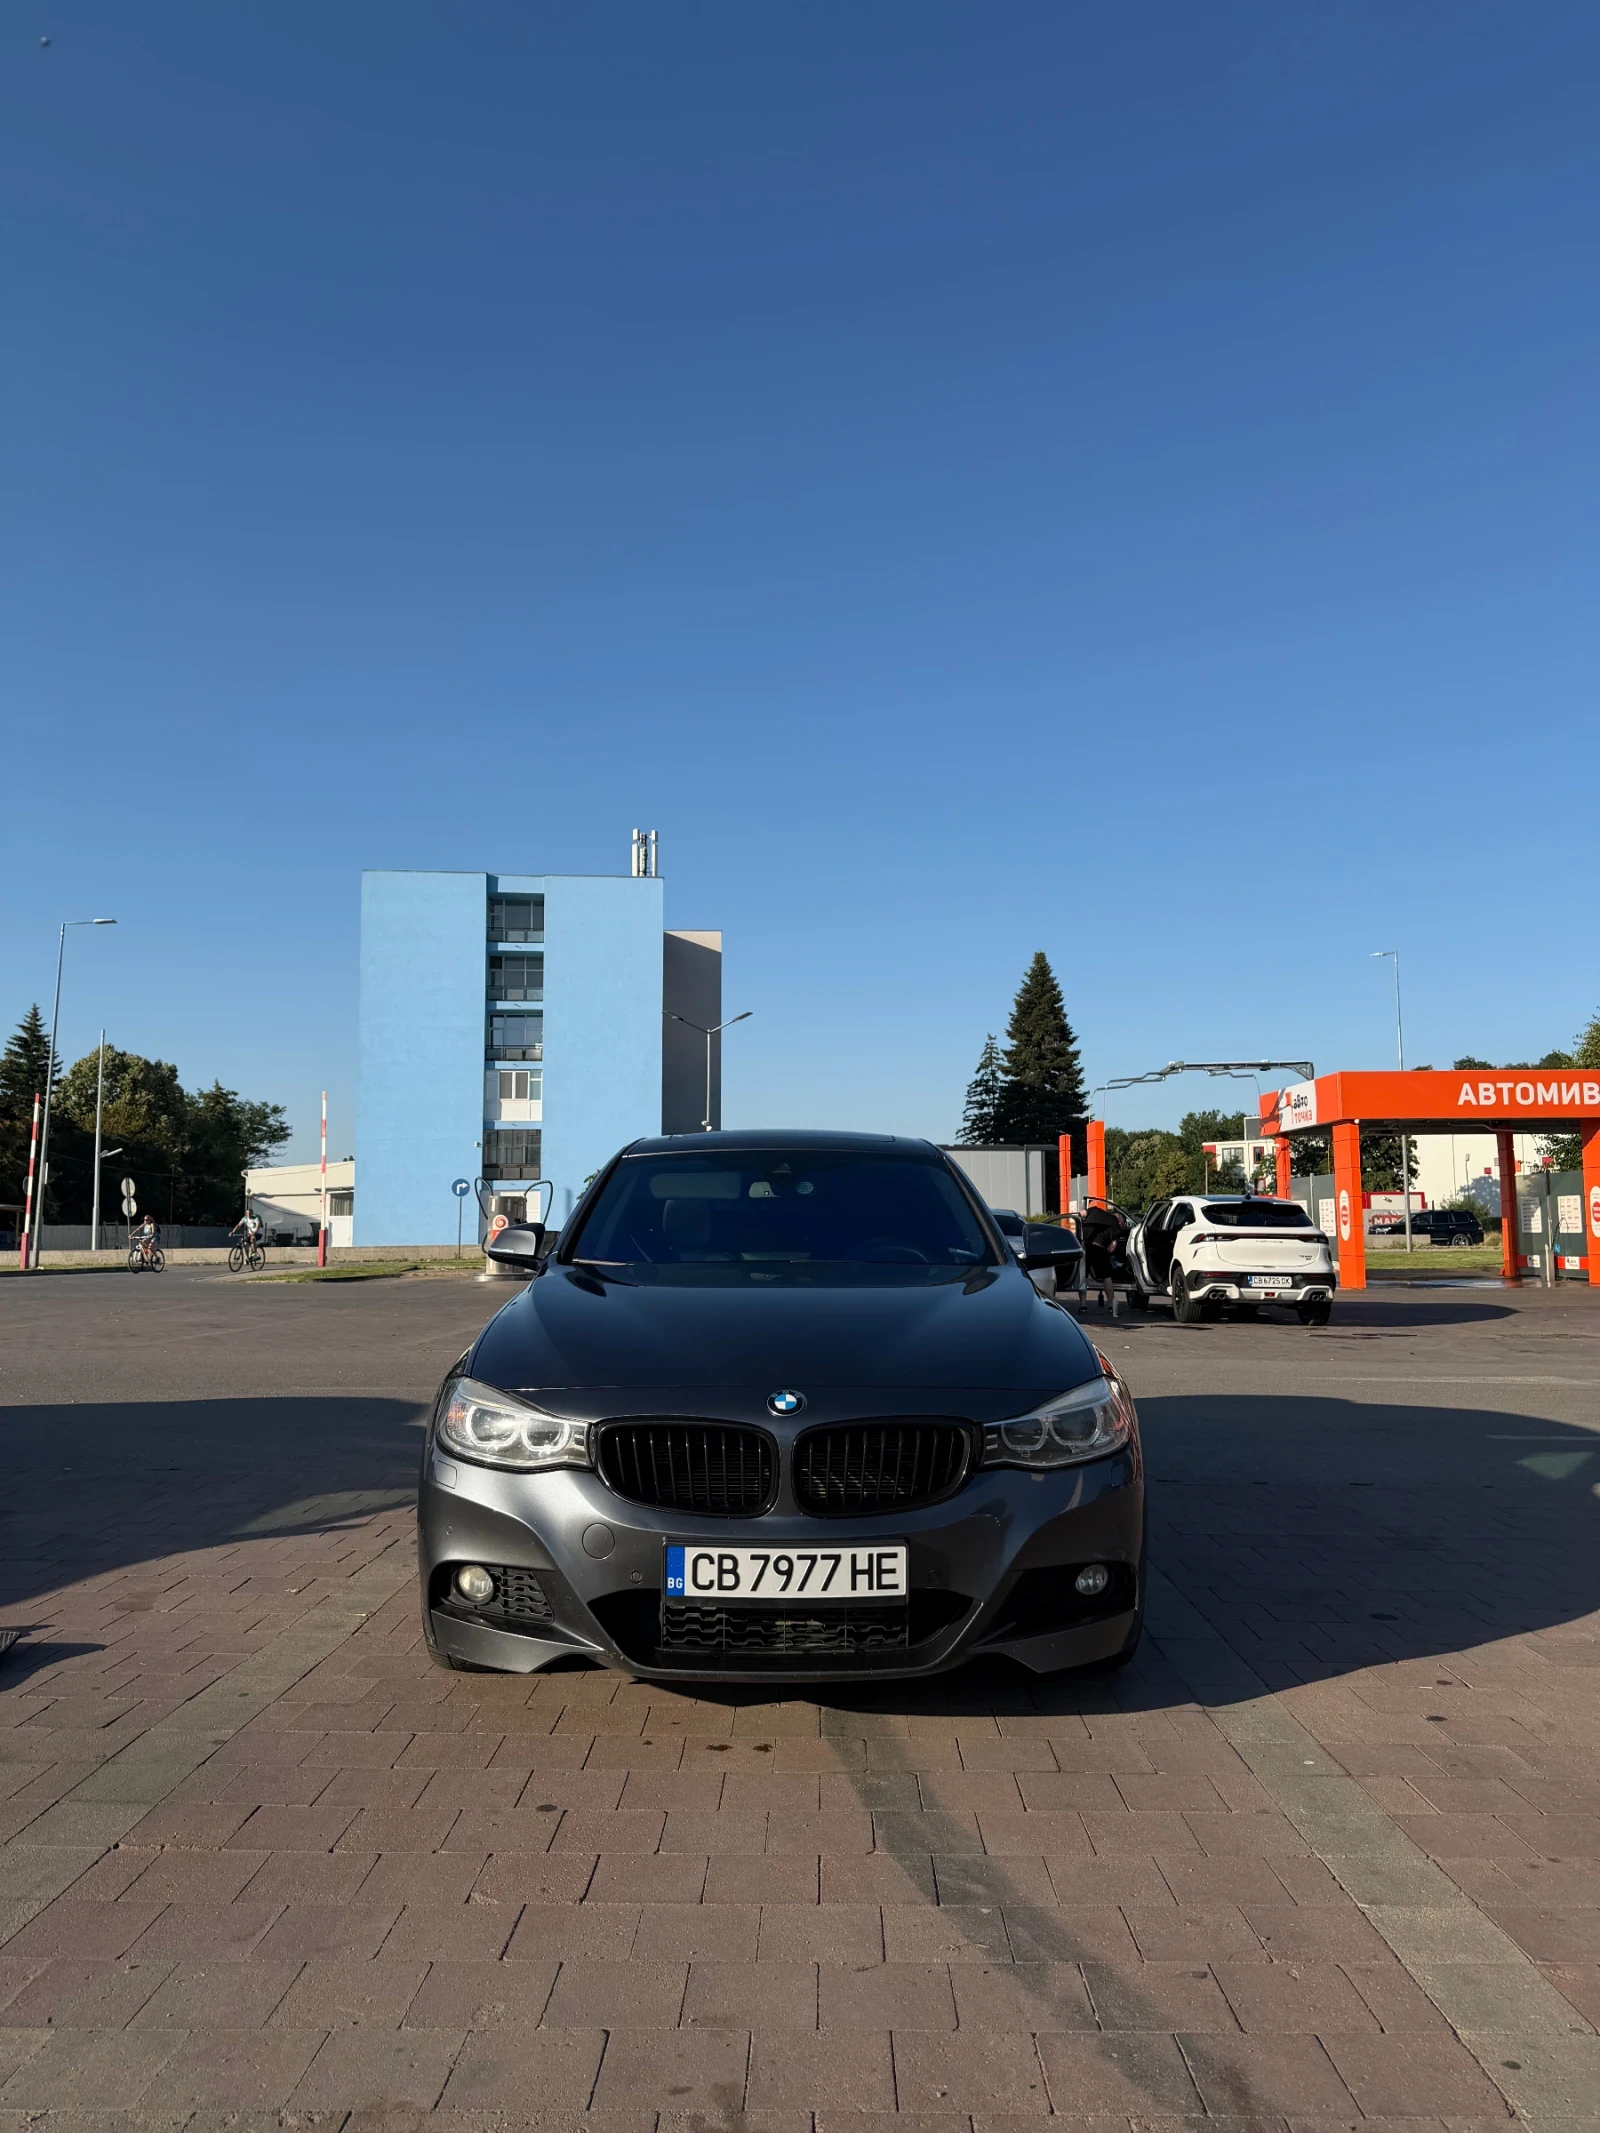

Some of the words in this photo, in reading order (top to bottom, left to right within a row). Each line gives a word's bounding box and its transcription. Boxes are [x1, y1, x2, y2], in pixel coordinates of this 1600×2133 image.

[1457, 1082, 1600, 1106] АВТОМИВ
[1294, 1109, 1313, 1124] точка
[1264, 1277, 1281, 1285] 6725
[692, 1553, 740, 1591] CB
[750, 1553, 842, 1592] 7977
[851, 1552, 899, 1591] HE
[667, 1577, 683, 1589] BG
